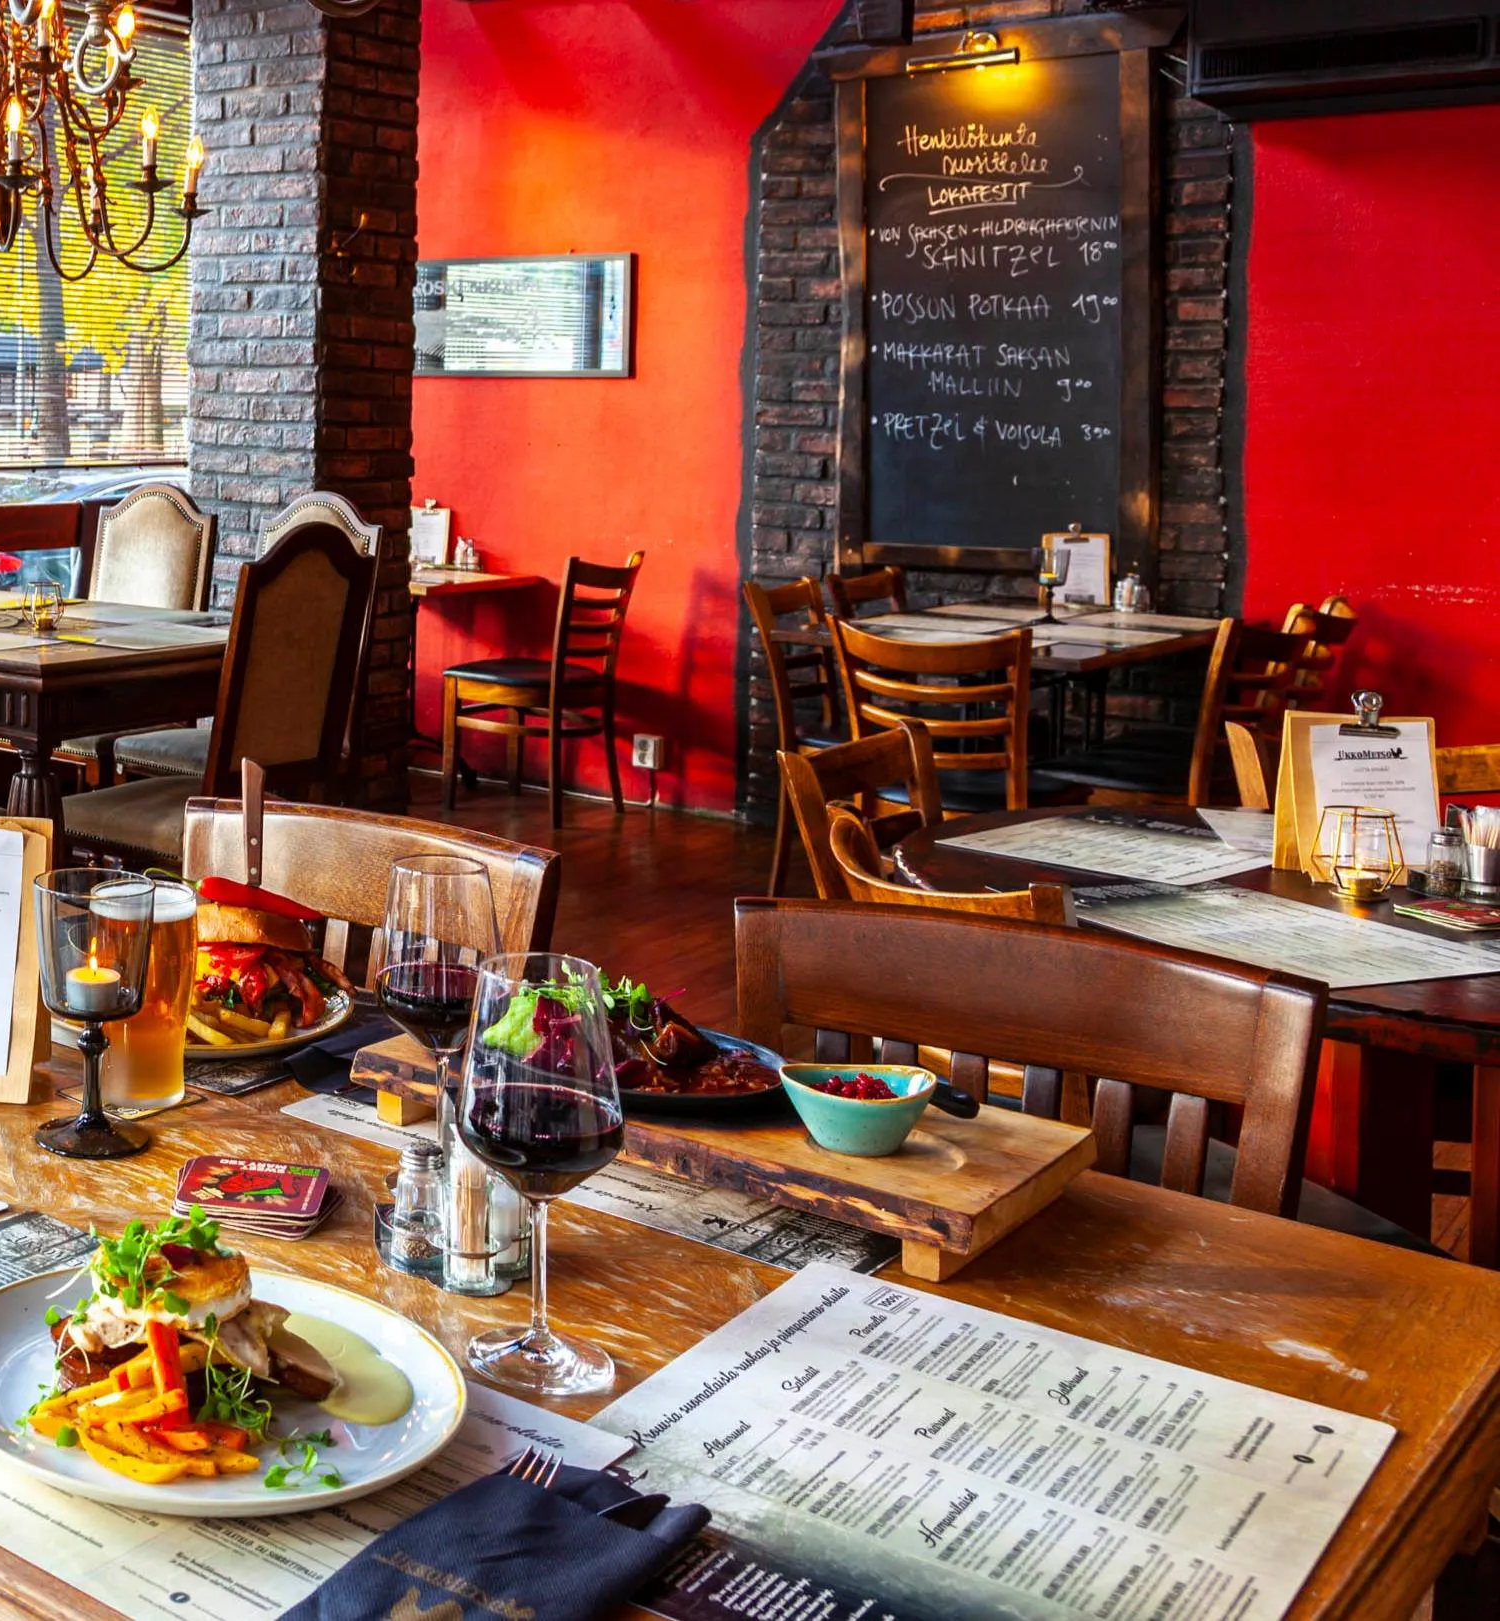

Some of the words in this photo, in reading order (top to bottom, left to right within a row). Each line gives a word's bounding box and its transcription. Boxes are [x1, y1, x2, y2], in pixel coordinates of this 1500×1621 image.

[897, 122, 1040, 156] Henkilökunta
[942, 152, 1049, 176] suosittelee
[879, 227, 900, 242] VON
[881, 290, 956, 324] POSSUN
[969, 293, 1050, 321] POTKAA
[882, 341, 987, 371] MAKKARAT
[996, 343, 1072, 371] SAKSAN
[931, 371, 1022, 397] MALLIIN
[680, 1369, 740, 1414] suomalaista
[733, 1346, 770, 1372] ruokaa
[768, 1335, 782, 1354] ja
